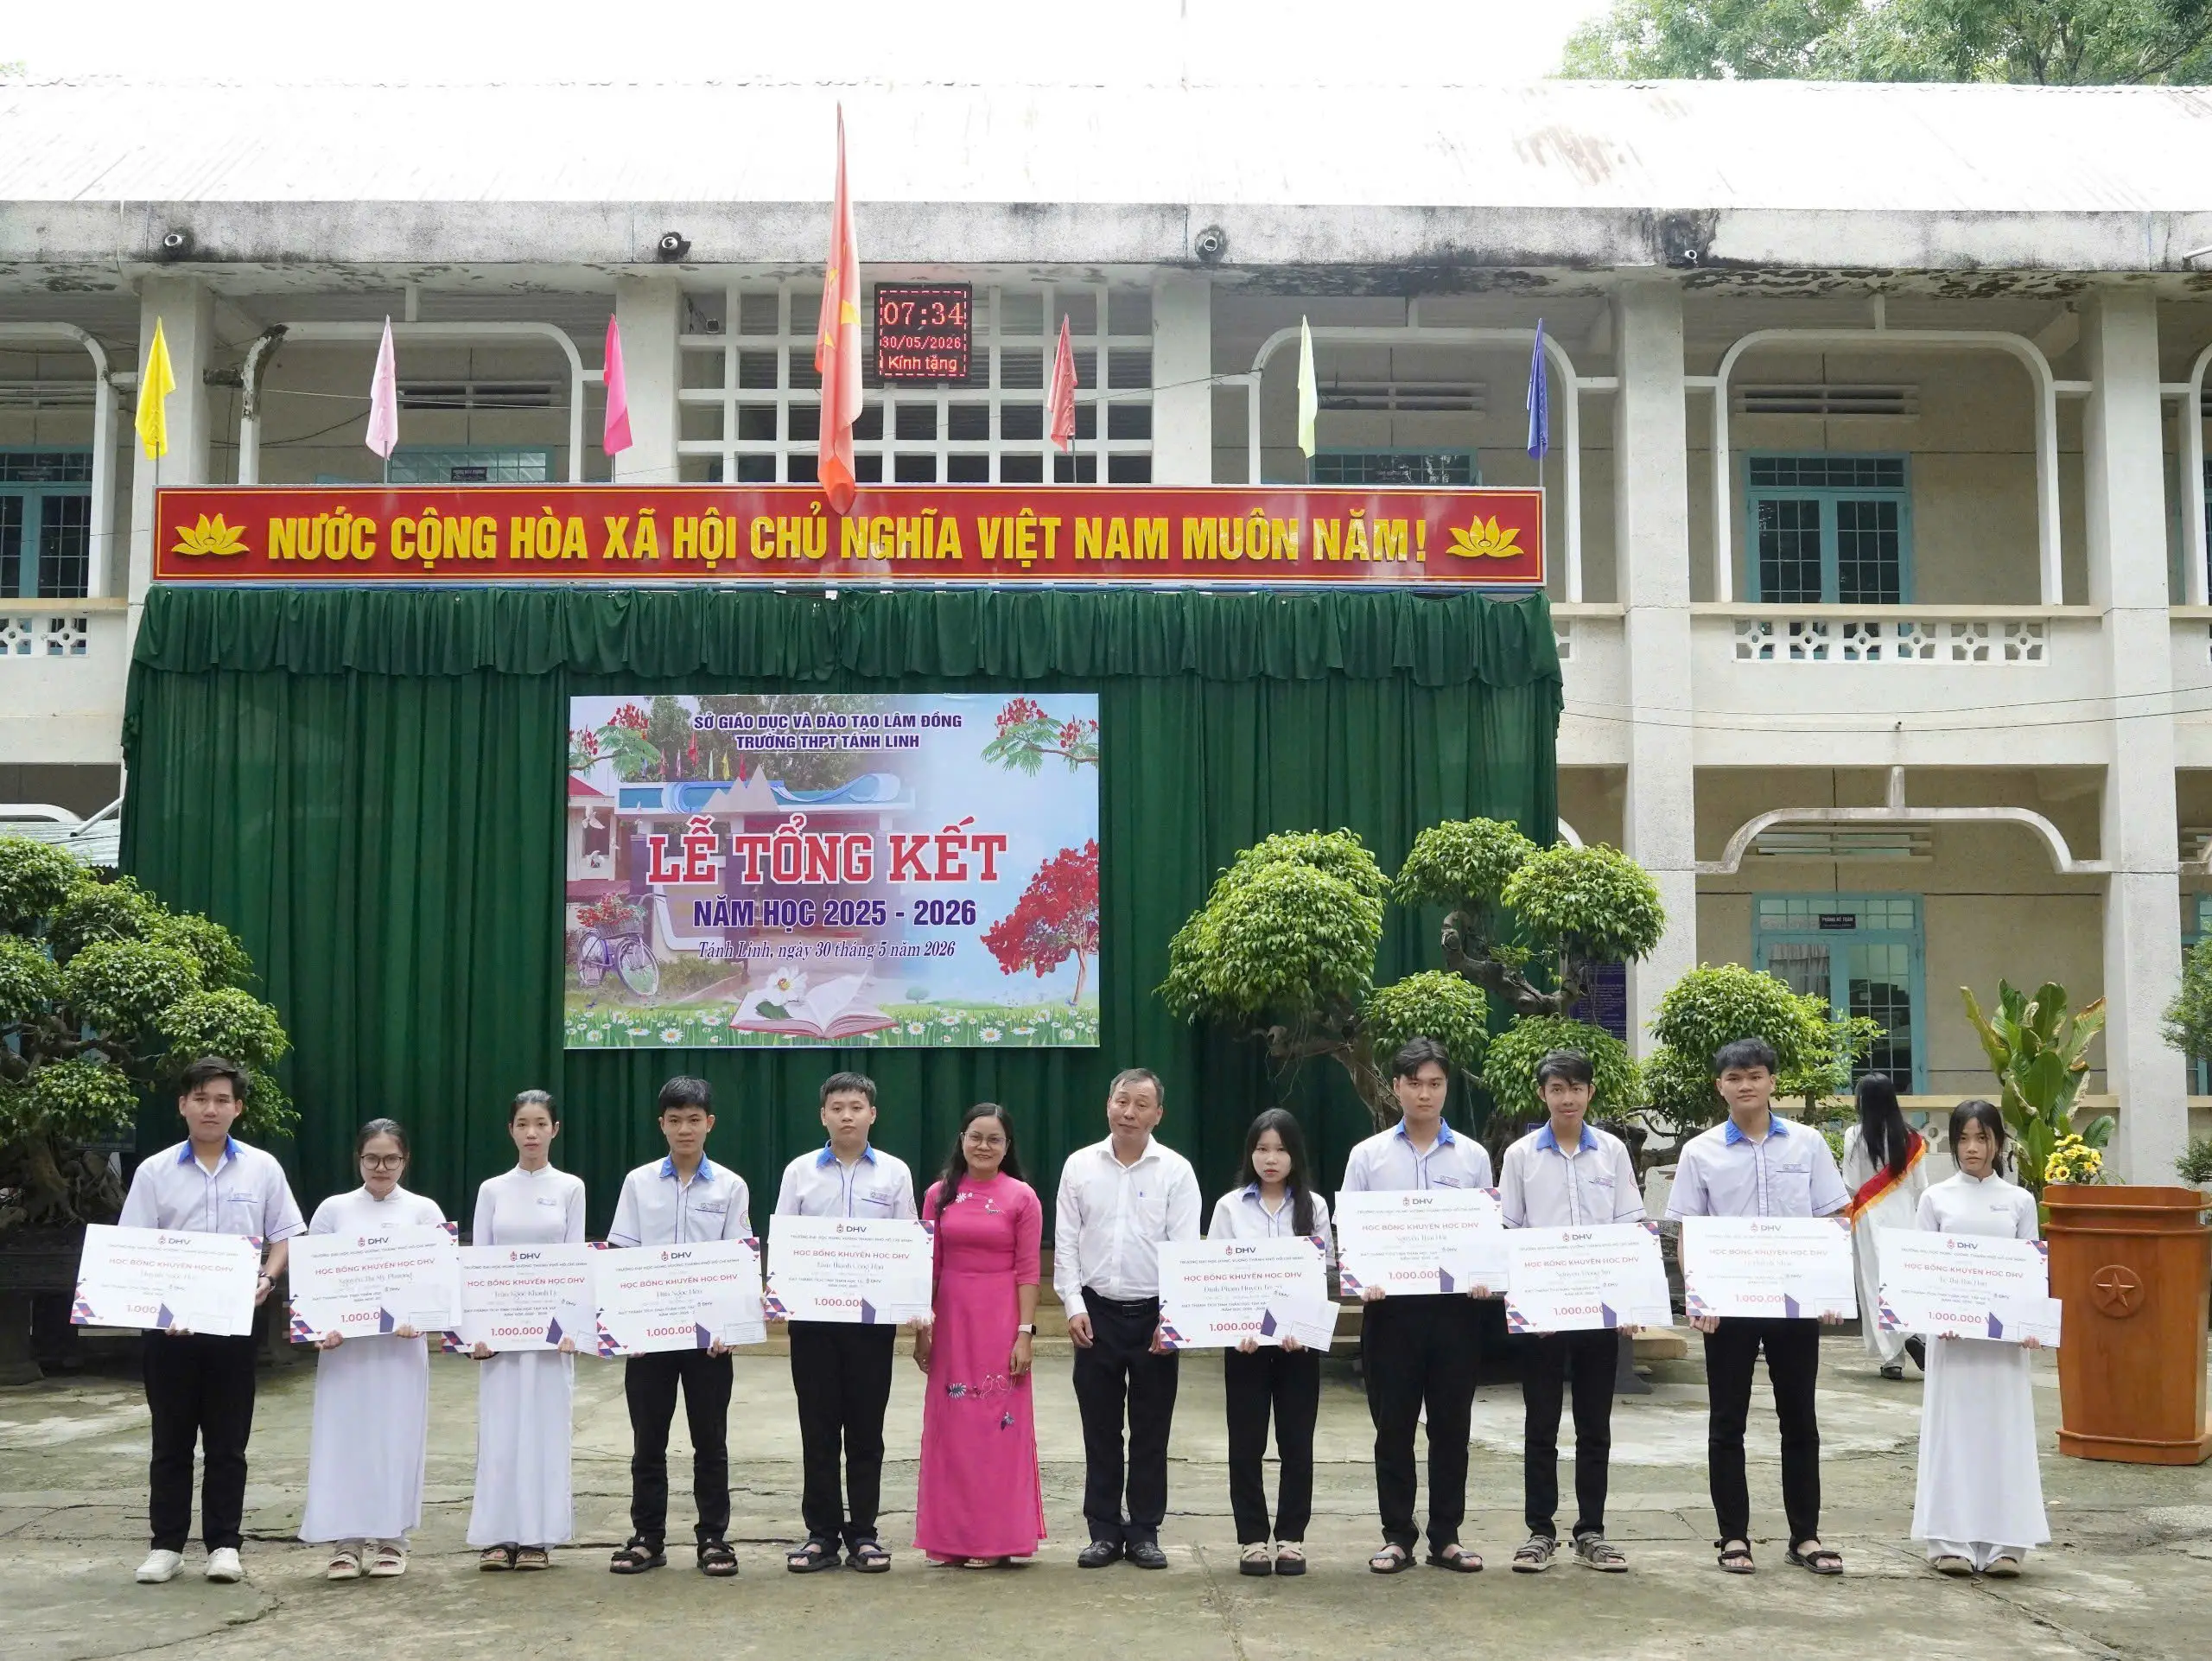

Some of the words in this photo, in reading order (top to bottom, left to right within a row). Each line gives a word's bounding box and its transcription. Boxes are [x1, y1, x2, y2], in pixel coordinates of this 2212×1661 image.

[884, 302, 963, 325] 07:34
[881, 334, 961, 350] 30/05/2026
[888, 354, 921, 370] Kính
[925, 354, 957, 372] tặng
[269, 506, 376, 561] NƯỚC
[391, 508, 496, 570] CỘNG
[512, 506, 587, 560] HÒA
[602, 508, 658, 560] XÃ
[674, 508, 734, 570] HỘI
[751, 500, 825, 560] CHỦ
[842, 508, 962, 560] NGHĨA
[978, 507, 1062, 568] VIỆT
[1076, 517, 1168, 560] NAM
[1183, 508, 1299, 561] MUÔN
[1313, 509, 1427, 563] NĂM!
[694, 712, 716, 729] SỞ
[718, 711, 756, 729] GIÁO
[758, 714, 789, 733] DỤC
[790, 711, 814, 729] VÀ
[816, 711, 847, 729] ĐÀO
[849, 715, 881, 733] TẠO
[883, 711, 917, 729] LÂM
[919, 710, 963, 729] ĐỒNG
[736, 731, 798, 750] TRƯỜNG
[800, 734, 837, 750] THPT
[839, 730, 882, 750] TÁNH
[884, 734, 920, 750] LINH
[646, 815, 719, 886] LỄ
[734, 812, 874, 885] TỔNG
[887, 816, 1007, 884] KẾT
[693, 896, 754, 928] NĂM
[763, 899, 815, 933] HỌC
[822, 899, 888, 927] 2025
[894, 911, 906, 920] -
[912, 899, 977, 927] 2026
[697, 940, 735, 958] Tánh
[736, 941, 774, 960] Linh,
[777, 942, 813, 963] ngày
[815, 940, 833, 958] 30
[834, 940, 878, 961] tháng
[879, 941, 889, 958] 5
[889, 942, 922, 958] năm
[924, 940, 956, 958] 2026
[367, 1237, 389, 1245] DHV
[1956, 1242, 1979, 1251] DHV
[548, 1277, 565, 1286] HỌC
[1388, 1270, 1440, 1280] 1.000.000
[620, 1281, 638, 1289] HỌC
[340, 1311, 380, 1323] 1.000.0
[1928, 1311, 1982, 1325] 1.000.000
[491, 1327, 543, 1337] 1.000.000
[1209, 1321, 1262, 1333] 1.000.000
